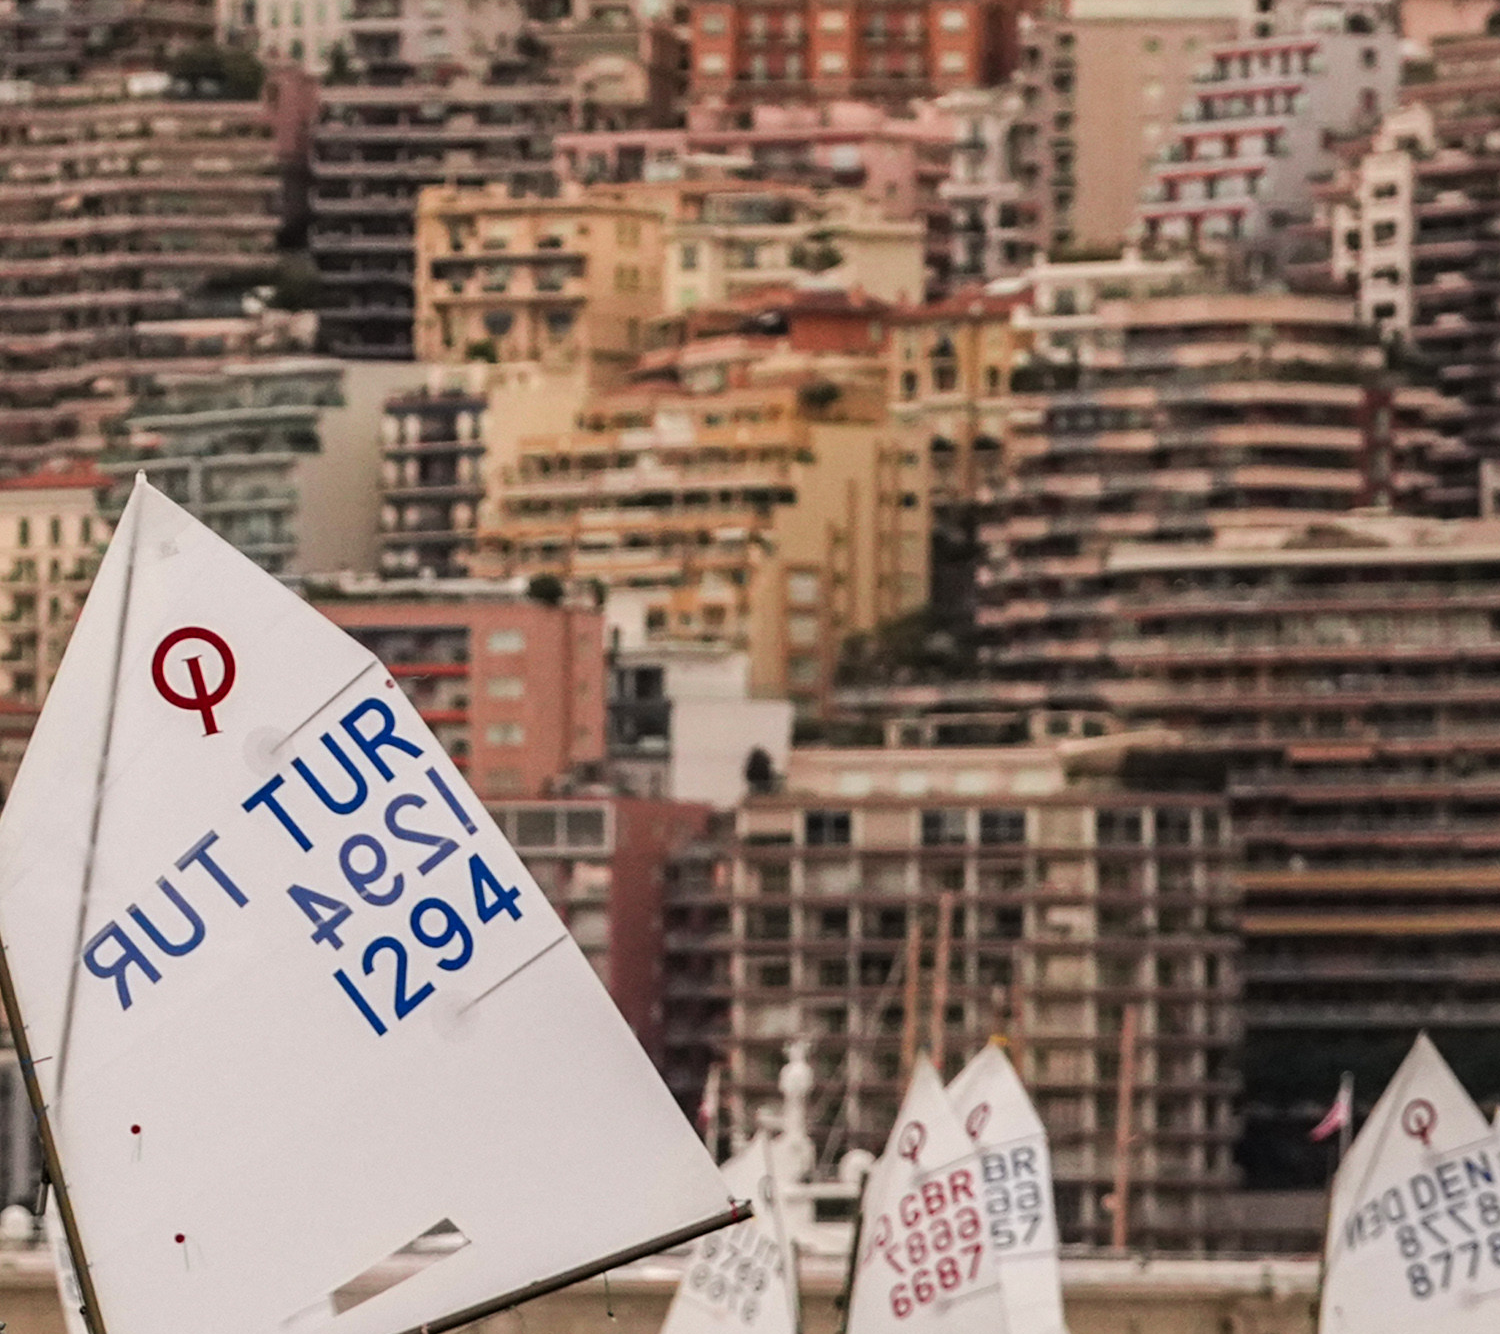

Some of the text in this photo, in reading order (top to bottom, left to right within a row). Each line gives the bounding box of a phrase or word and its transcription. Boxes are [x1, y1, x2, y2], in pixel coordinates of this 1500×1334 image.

[241, 697, 424, 853] TUR
[333, 853, 522, 1037] 1294
[899, 1169, 975, 1227] GBR
[981, 1146, 1037, 1183] BR
[1409, 1150, 1494, 1210] DEN
[889, 1242, 983, 1318] 6687
